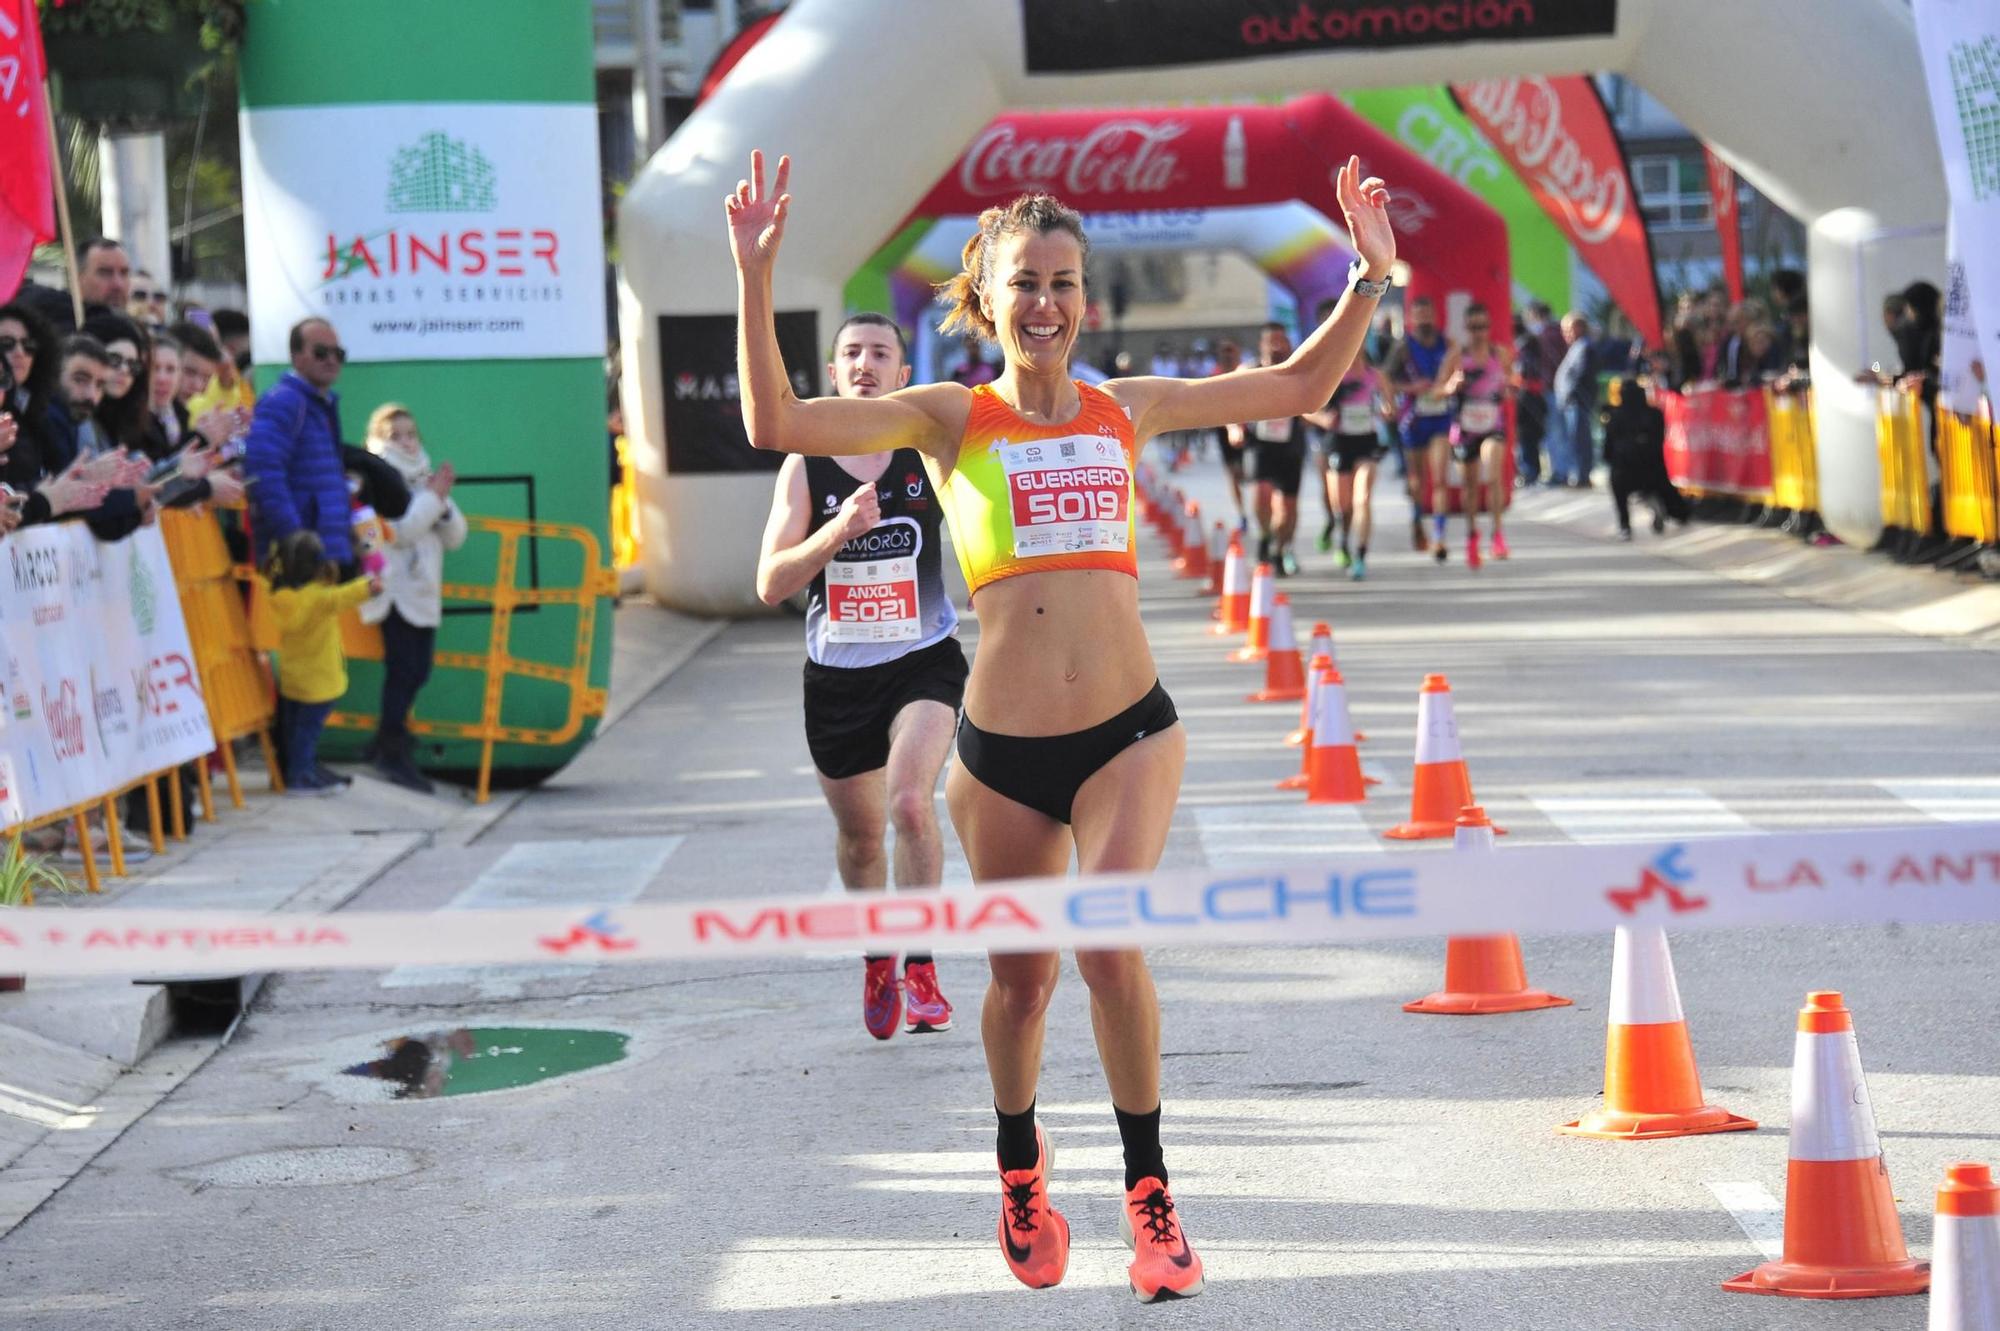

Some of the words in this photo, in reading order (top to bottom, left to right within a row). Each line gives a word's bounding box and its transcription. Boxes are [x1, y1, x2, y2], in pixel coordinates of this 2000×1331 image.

[958, 118, 1190, 197] Coca-Cola
[323, 229, 561, 279] JAINSER
[370, 317, 524, 335] www.jainser.com
[1016, 468, 1125, 491] GUERRERO
[1029, 490, 1119, 524] 5019
[847, 584, 898, 599] ANXOL
[839, 598, 907, 622] 5021
[1745, 857, 1825, 891] LA
[694, 893, 1043, 943] MEDIA
[1065, 868, 1419, 930] ELCHE
[83, 927, 347, 949] ANTIGUA
